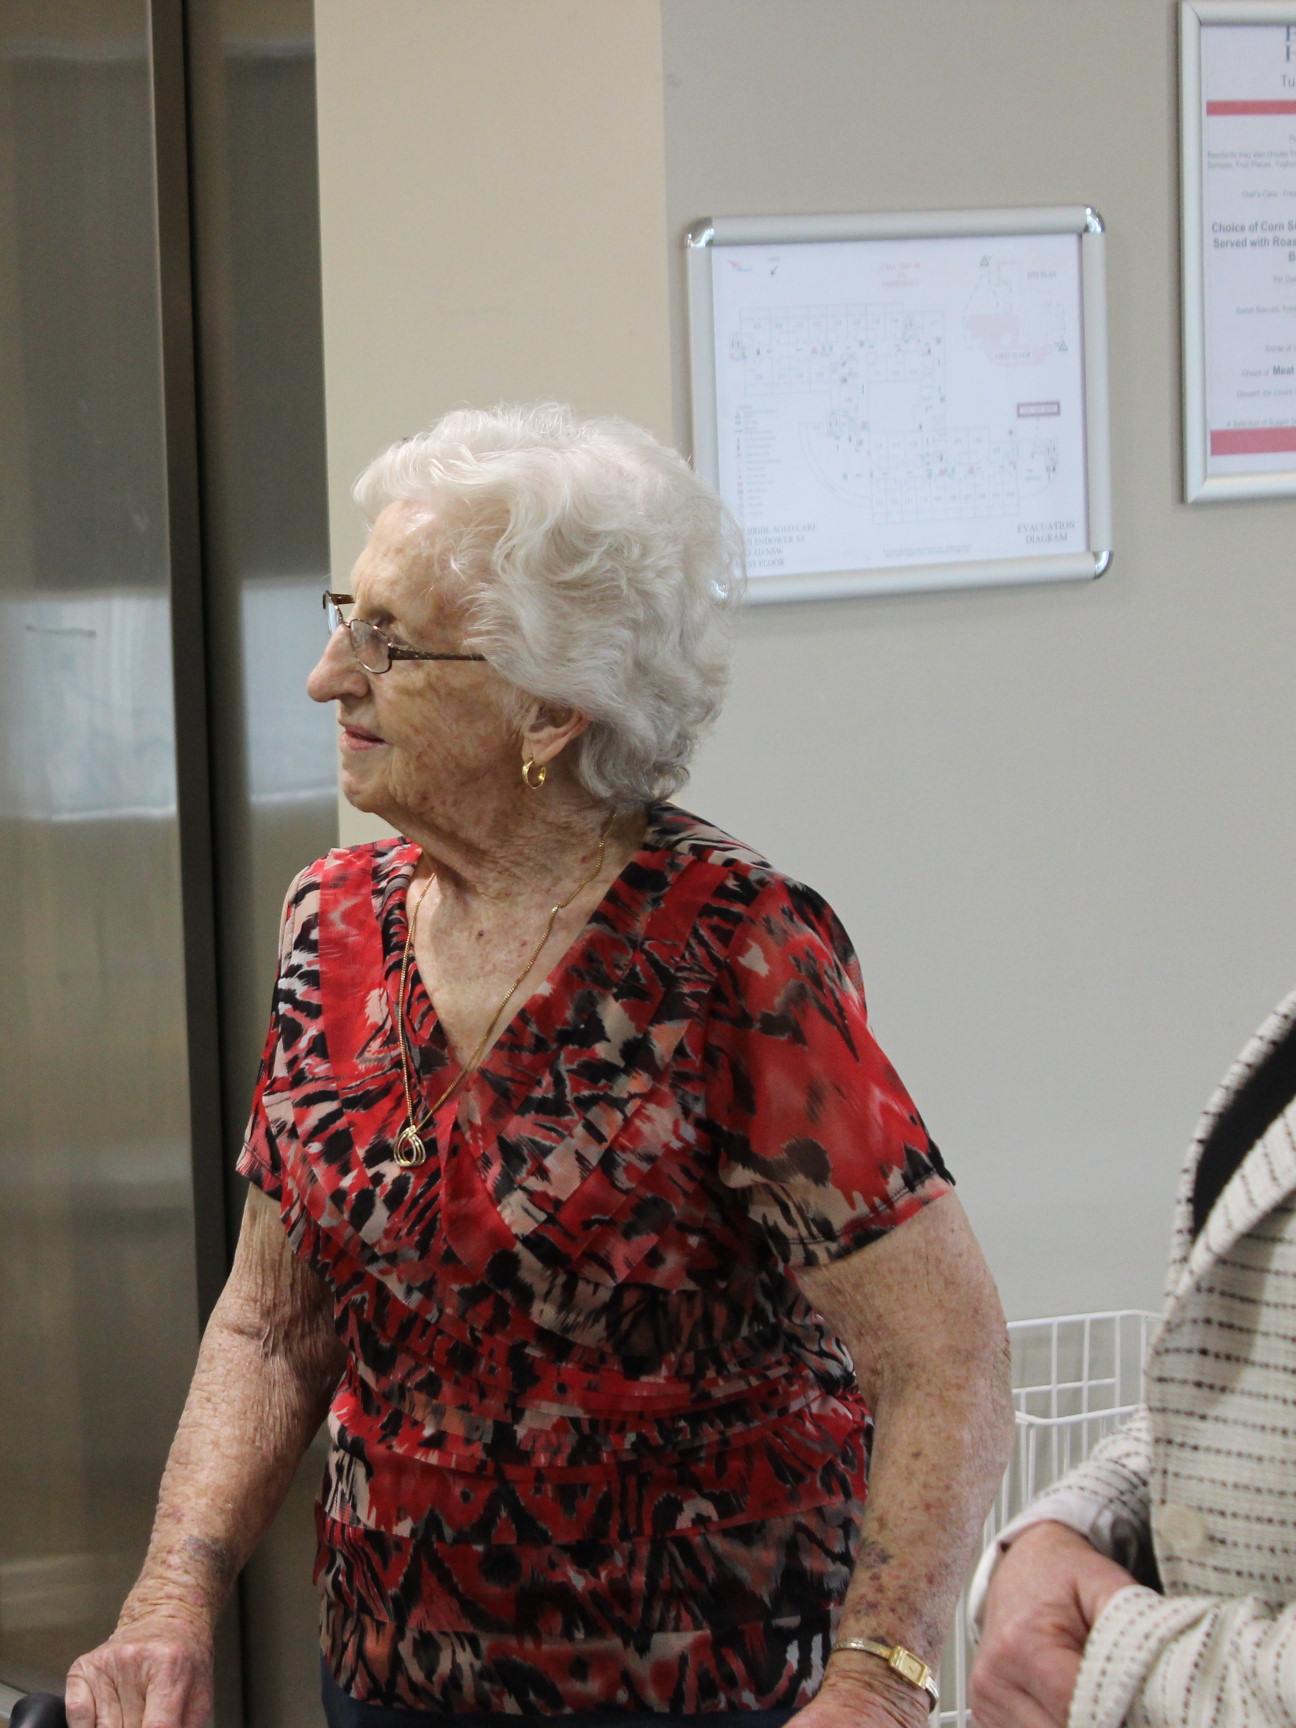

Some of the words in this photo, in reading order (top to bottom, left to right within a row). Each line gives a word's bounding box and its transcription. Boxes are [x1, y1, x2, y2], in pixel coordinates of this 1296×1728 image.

[1211, 221, 1246, 233] Choice
[1248, 221, 1259, 232] of
[1260, 220, 1285, 231] Corn
[1213, 237, 1248, 249] Served
[1249, 237, 1270, 248] with
[1272, 365, 1294, 375] Meat
[1017, 520, 1075, 533] EVACUATION
[1025, 532, 1068, 544] DIAGRAM
